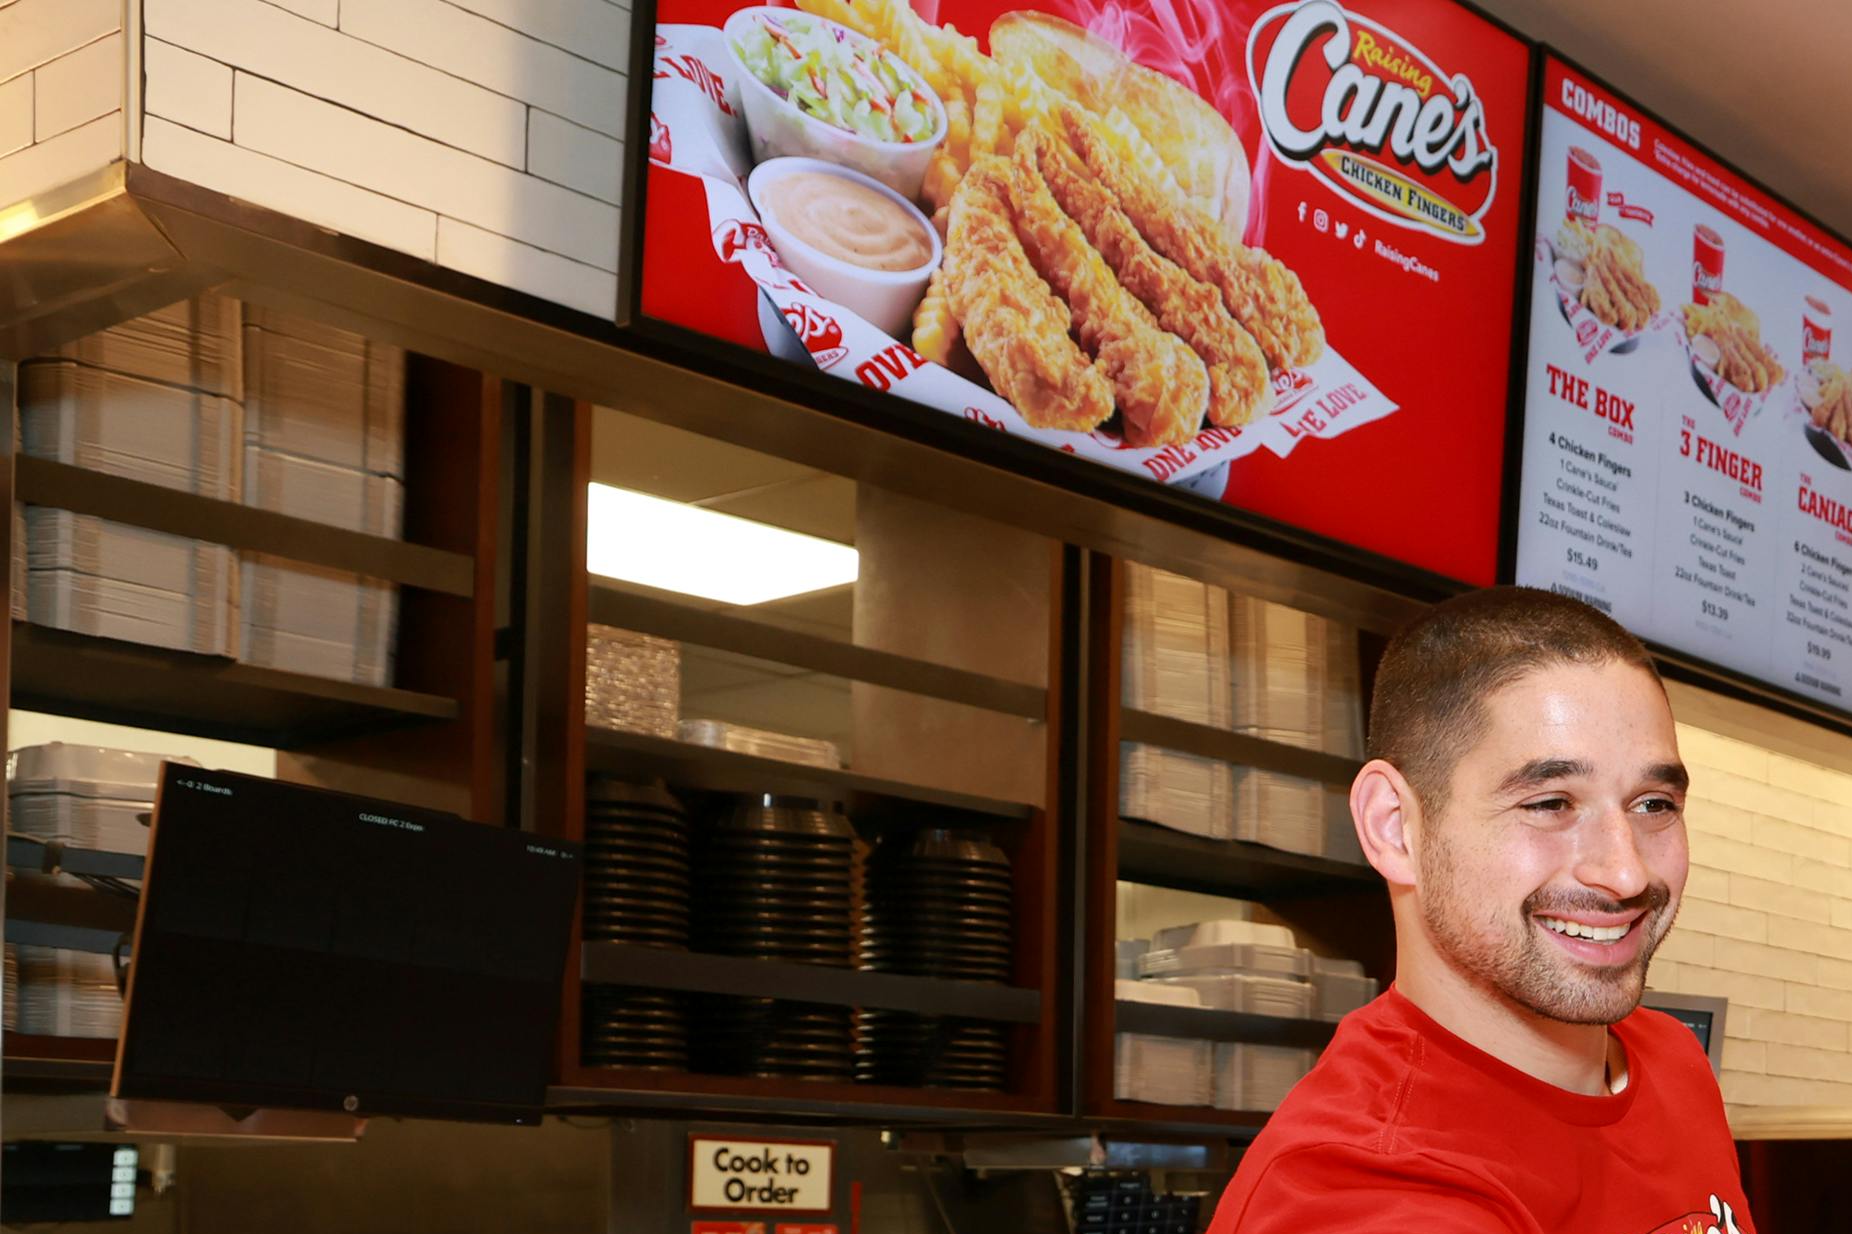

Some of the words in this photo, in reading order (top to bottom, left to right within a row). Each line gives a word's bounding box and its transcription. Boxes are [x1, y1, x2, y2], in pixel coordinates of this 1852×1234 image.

[1354, 30, 1433, 97] Raising
[1261, 1, 1493, 178] Cane's
[1562, 78, 1641, 149] COMBOS
[1341, 157, 1402, 200] CHICKEN
[1408, 189, 1464, 231] FINGERS
[1375, 240, 1439, 281] RaisingCanes
[1326, 383, 1368, 418] LOVE
[1545, 362, 1588, 411] THE
[1594, 386, 1634, 432] BOX
[1549, 430, 1555, 444] 4
[1558, 433, 1595, 463] Chicken
[1597, 451, 1631, 481] Fingers
[1680, 428, 1691, 458] 3
[1696, 434, 1763, 492] FINGER
[1691, 493, 1724, 520] Chicken
[1725, 508, 1754, 536] Fingers
[1566, 546, 1598, 573] $15.49
[714, 1147, 779, 1174] Cook
[786, 1154, 810, 1176] to
[723, 1177, 799, 1204] Order
